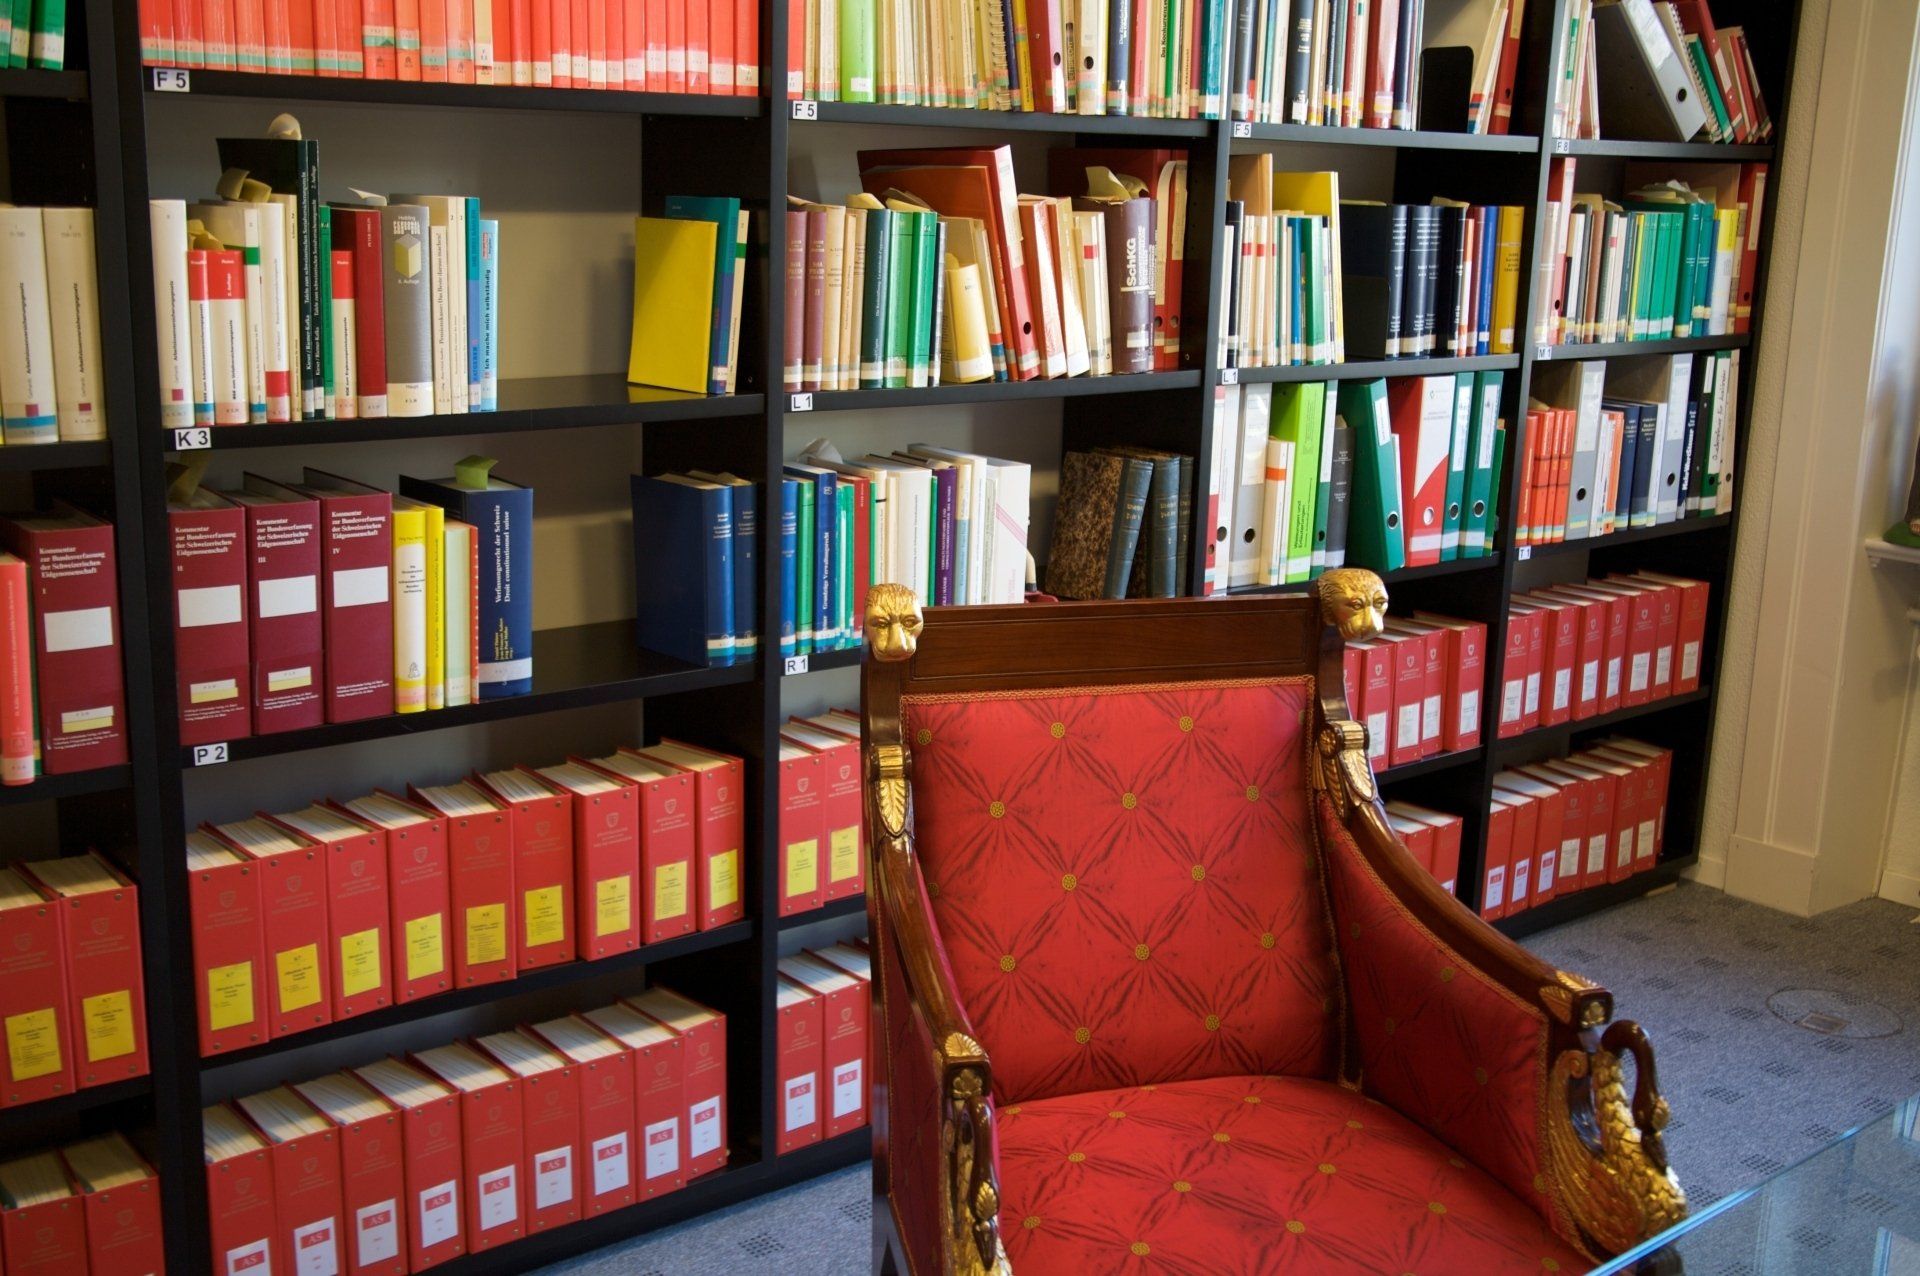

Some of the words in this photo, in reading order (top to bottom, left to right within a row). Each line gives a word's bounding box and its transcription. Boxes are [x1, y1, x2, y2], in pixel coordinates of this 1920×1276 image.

[156, 71, 167, 87] F
[175, 72, 186, 88] 5
[794, 104, 803, 116] F
[807, 104, 815, 117] 5
[1235, 123, 1241, 135] F
[1244, 124, 1250, 136] 5
[1127, 238, 1137, 286] SchKG
[1223, 371, 1229, 382] L
[1232, 371, 1237, 382] 1
[793, 397, 801, 409] L
[805, 396, 812, 408] 1
[178, 431, 191, 447] K
[198, 430, 208, 445] 3
[342, 516, 386, 525] Bundesverfassung
[267, 524, 313, 533] Bundesverfassung
[342, 523, 382, 532] Schweizerischen
[186, 531, 236, 541] Bundesverfassung
[267, 531, 308, 540] Schweizerischen
[332, 530, 379, 539] Eidgenossenschaft
[258, 538, 305, 547] Eidgenossenschaft
[177, 547, 228, 556] Eidgenossenschaft
[52, 552, 106, 562] Bundesverfassung
[52, 561, 101, 569] Schweizerischen
[41, 568, 97, 578] Eidgenossenschaft
[787, 660, 796, 672] R
[801, 658, 806, 670] 1
[197, 748, 208, 763] P
[214, 745, 225, 760] 2
[700, 1110, 711, 1118] AS
[656, 1131, 668, 1139] AS
[606, 1147, 617, 1155] AS
[547, 1161, 561, 1170] AS
[490, 1180, 504, 1189] AS
[432, 1196, 446, 1206] AS
[370, 1216, 384, 1225] AS
[309, 1233, 323, 1243] AS
[242, 1255, 257, 1265] AS
